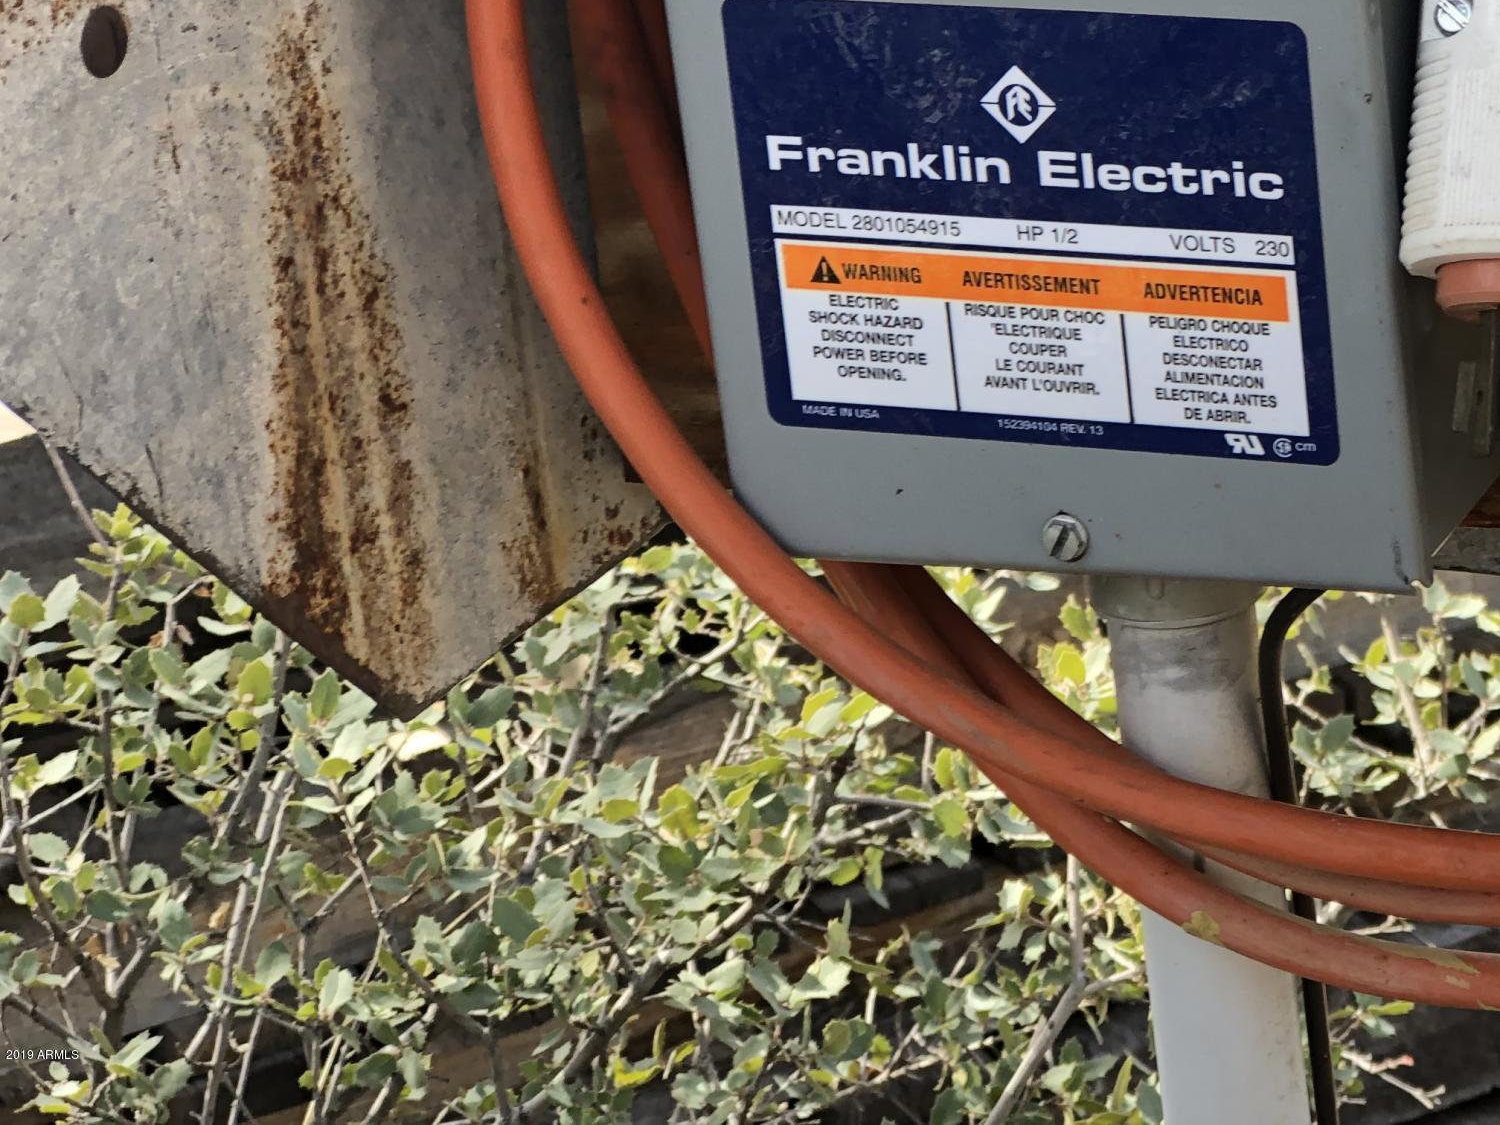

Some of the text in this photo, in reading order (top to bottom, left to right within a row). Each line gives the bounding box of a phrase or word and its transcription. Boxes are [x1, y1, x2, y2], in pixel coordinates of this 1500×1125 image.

[766, 135, 1284, 200] Franklin Electric
[777, 210, 1290, 257] MODEL 2801054915 HP 1/2 VOLTS 230
[842, 263, 922, 284] WARNING
[962, 270, 1100, 294] AVERTISSEMENT
[829, 294, 898, 310] ELECTRIC
[1144, 283, 1262, 305] ADVERTENCIA
[809, 310, 923, 329] SHOCK HAZARD
[964, 303, 1104, 324] RISQUE POUR CHOC
[1149, 315, 1269, 335] PELIGRO CHOQUE
[821, 329, 913, 346] DISCONNECT
[1173, 335, 1248, 352] ELECTRICO
[813, 346, 927, 365] POWER BEFORE
[1009, 341, 1066, 357] COUPER
[996, 359, 1084, 375] LE COURANT
[1162, 352, 1262, 370] DESCONECTAR
[838, 365, 906, 381] OPENING.
[1164, 371, 1263, 389] ALIMENTACION
[984, 376, 1099, 395] AVANT L'OUVRIR.
[1155, 387, 1276, 408] ELECTRICA ANTES
[1184, 407, 1250, 423] DE ABRIR.
